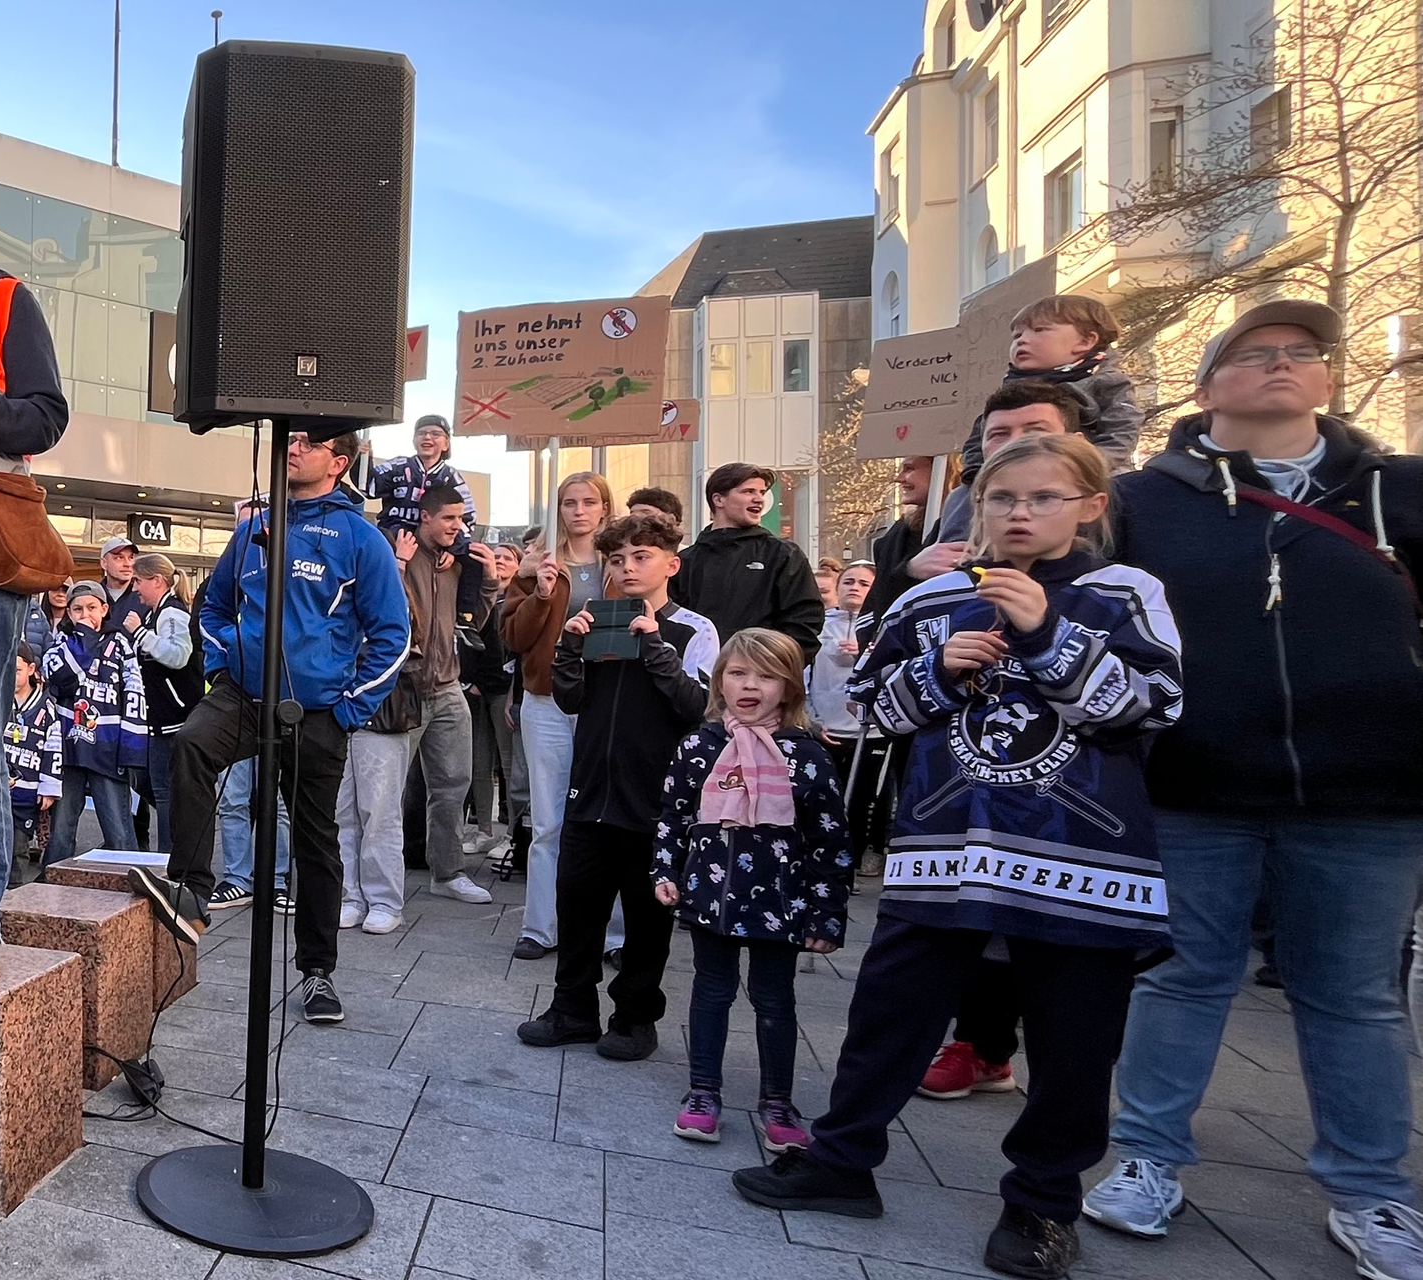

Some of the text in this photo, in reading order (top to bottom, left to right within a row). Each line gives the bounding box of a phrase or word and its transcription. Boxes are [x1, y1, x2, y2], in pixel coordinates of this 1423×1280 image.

[474, 311, 583, 338] Ihr nehmt
[473, 336, 571, 354] uns unser
[471, 351, 565, 370] 2. Zuhause
[883, 396, 939, 411] unseren
[139, 519, 168, 541] C&A
[292, 559, 326, 576] SGW
[1036, 741, 1077, 774] CLUB
